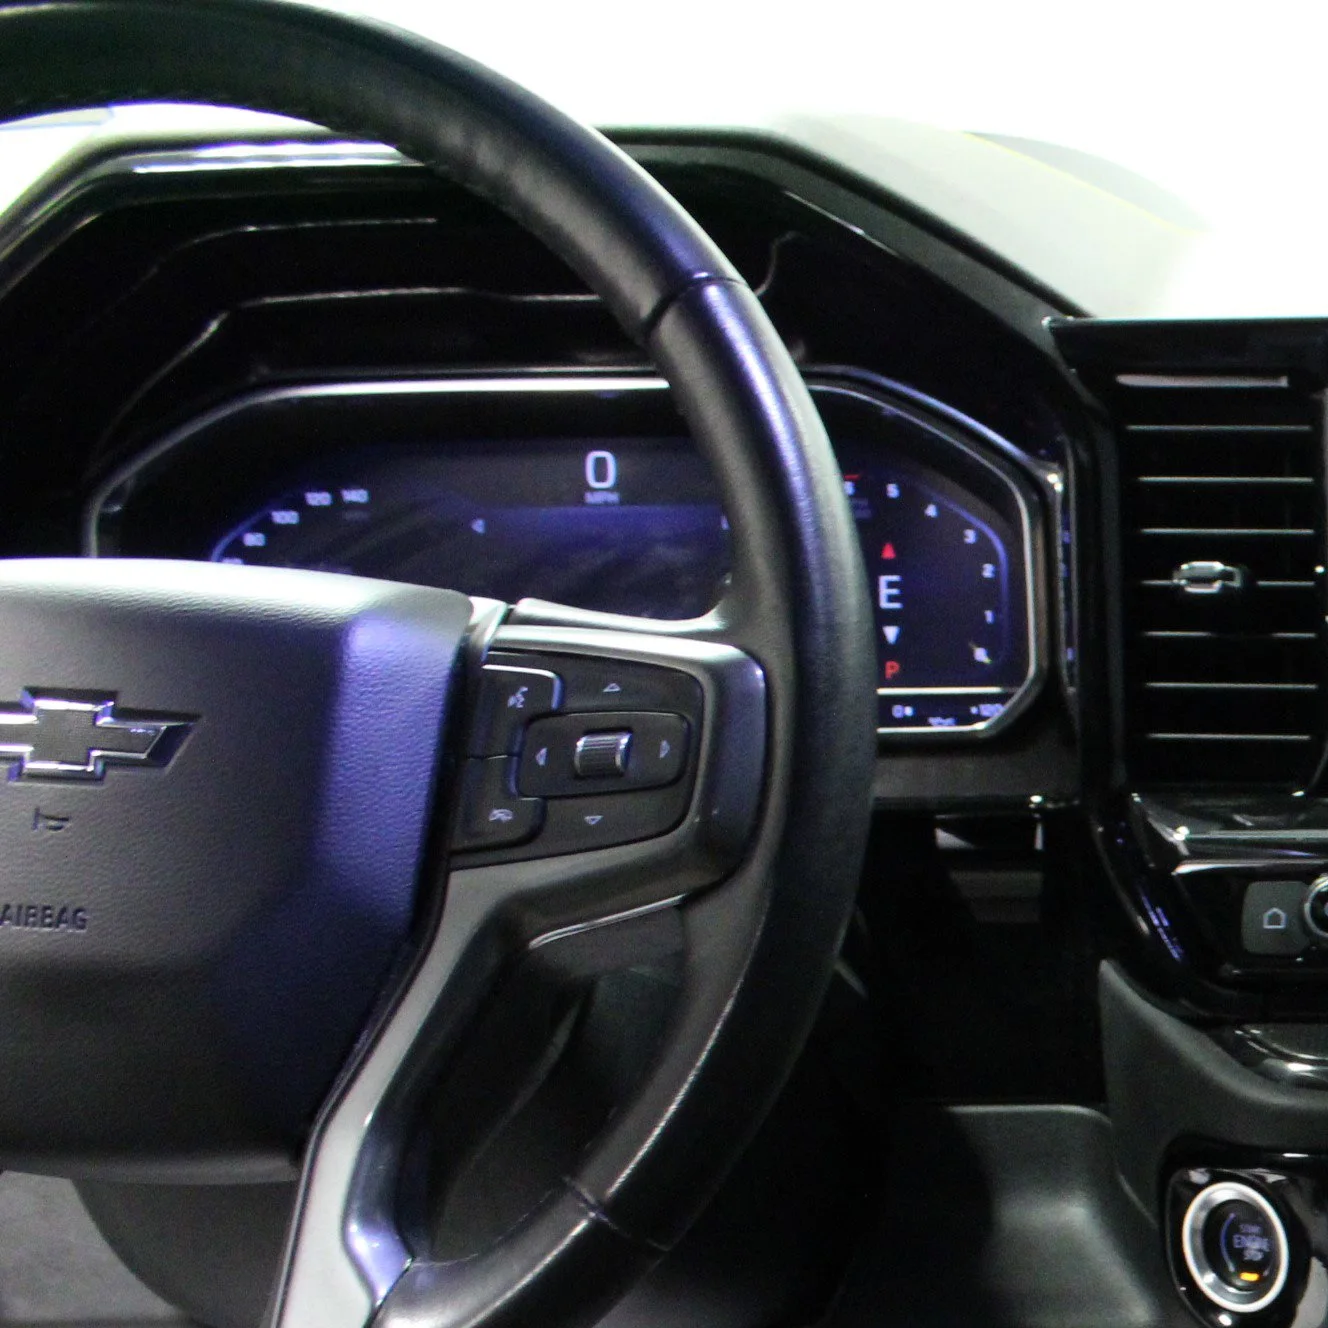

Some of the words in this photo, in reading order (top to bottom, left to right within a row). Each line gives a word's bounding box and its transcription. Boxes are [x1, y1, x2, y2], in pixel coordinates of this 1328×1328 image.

[584, 450, 618, 489] 0
[341, 488, 369, 503] 140
[886, 483, 900, 498] 5
[305, 491, 332, 506] 120
[271, 510, 299, 525] 100
[924, 503, 938, 518] 4
[963, 528, 977, 544] 3
[982, 563, 995, 578] 2
[879, 575, 903, 609] E
[984, 610, 994, 624] 1
[885, 660, 900, 679] P
[0, 904, 88, 932] AIRBAG
